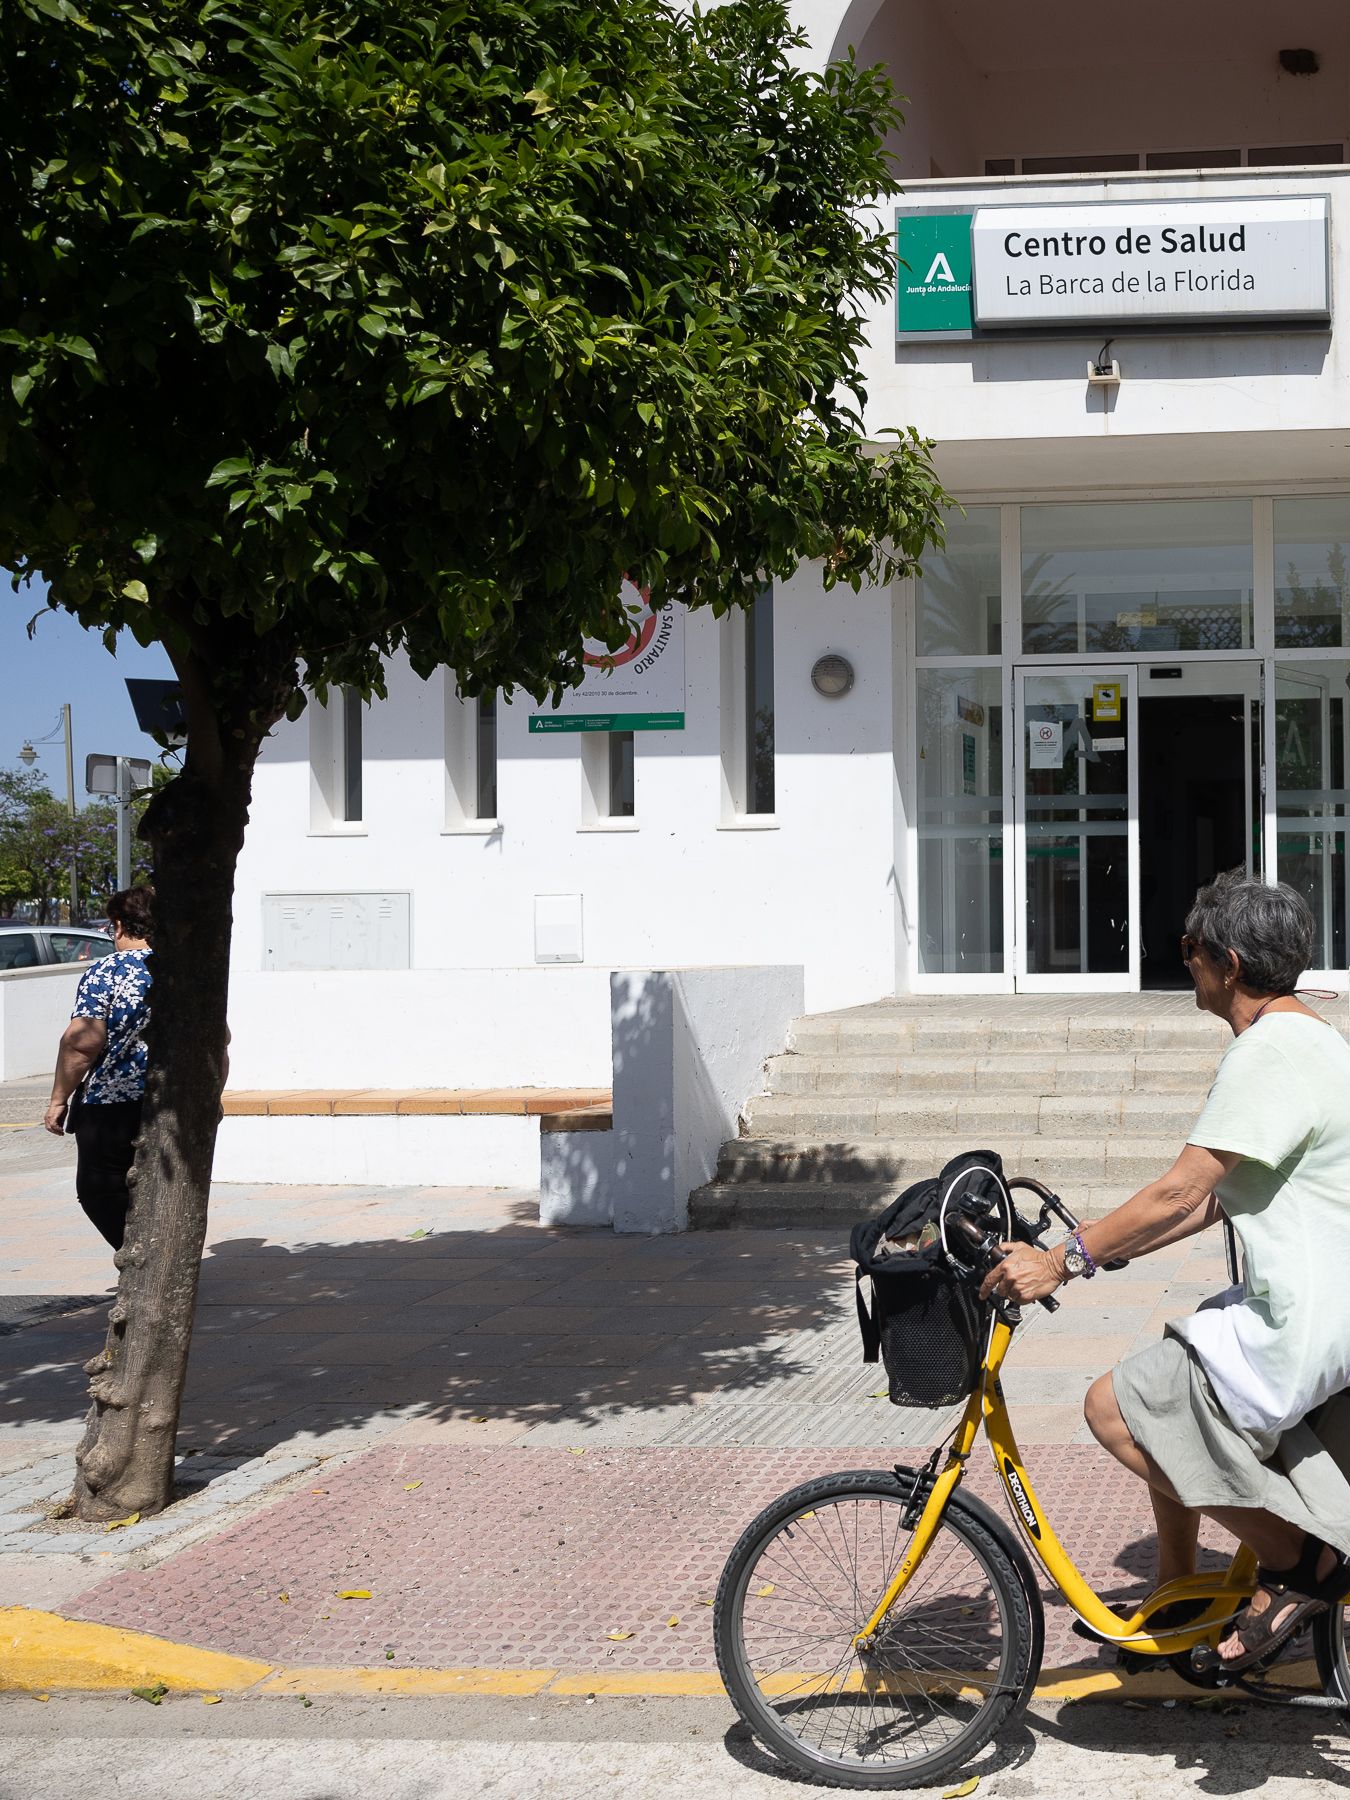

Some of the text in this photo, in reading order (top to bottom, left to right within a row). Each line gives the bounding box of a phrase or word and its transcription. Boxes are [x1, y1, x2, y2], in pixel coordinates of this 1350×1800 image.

[1004, 224, 1246, 258] Centro de Salud
[937, 284, 972, 292] Andalucía
[1006, 268, 1255, 295] La Barca de la Florida
[634, 615, 674, 675] SANITARIO
[1008, 1471, 1037, 1527] DECATHLON
